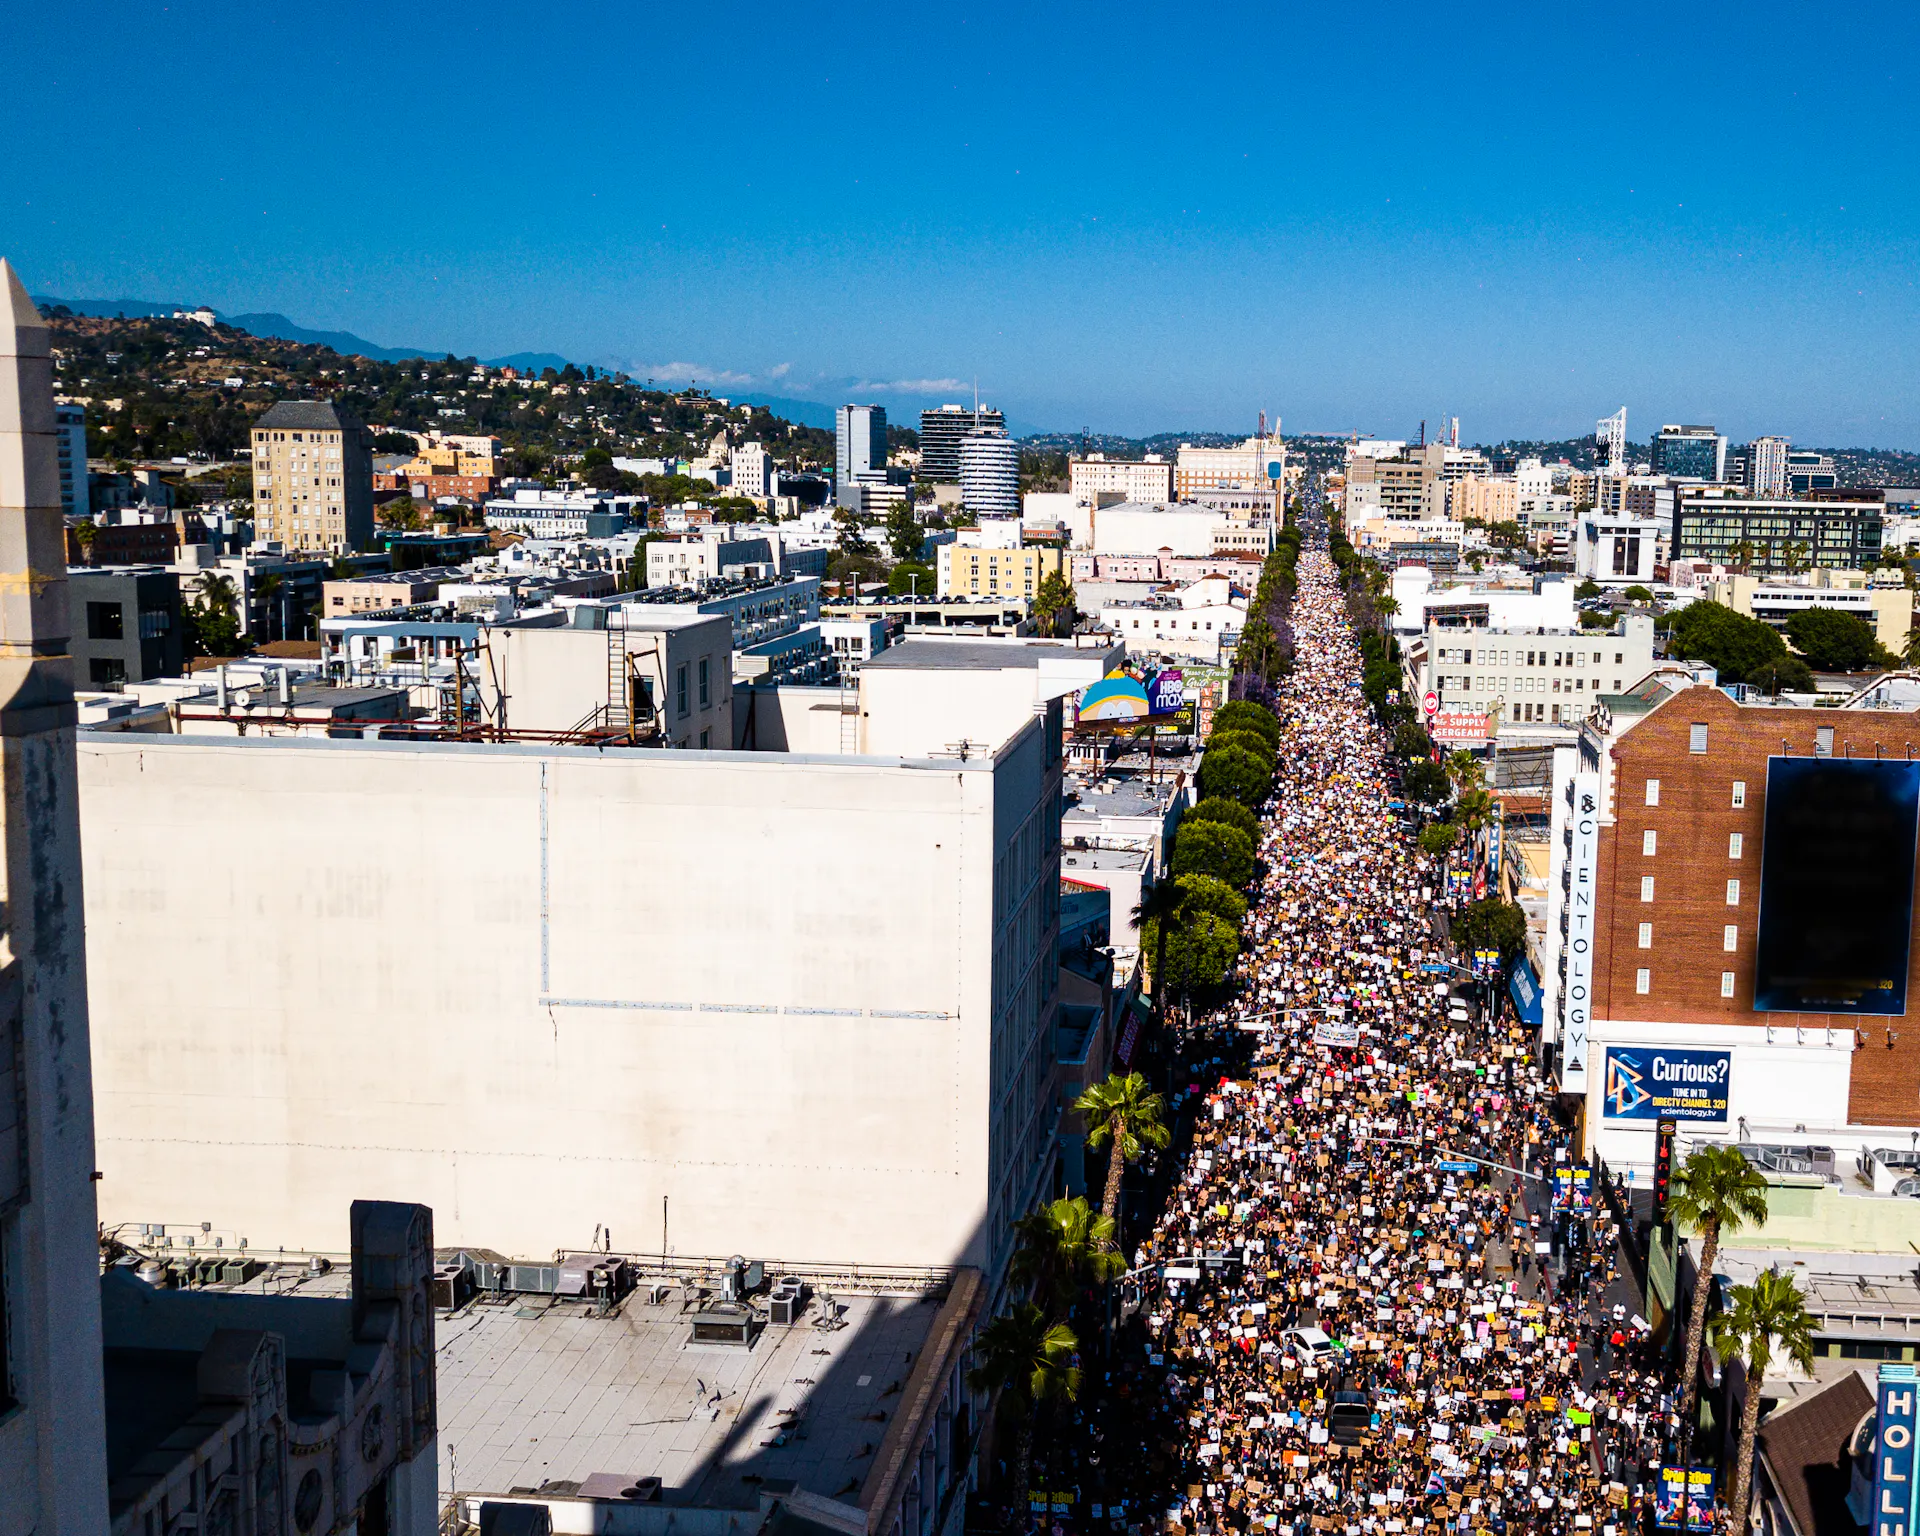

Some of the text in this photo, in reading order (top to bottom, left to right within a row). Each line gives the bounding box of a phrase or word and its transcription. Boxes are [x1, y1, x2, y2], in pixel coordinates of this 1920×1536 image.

[1160, 680, 1183, 694] HBO
[1156, 694, 1184, 708] max
[1202, 688, 1211, 732] VOGU
[1450, 718, 1485, 727] SUPPLY
[1437, 728, 1486, 737] SERGEANT
[1652, 1057, 1729, 1083] Curious?
[1672, 1088, 1708, 1098] TUNE IN TO
[1652, 1097, 1727, 1110] DIRECTV CHANNEL 320
[1660, 1108, 1717, 1118] scientology.tv
